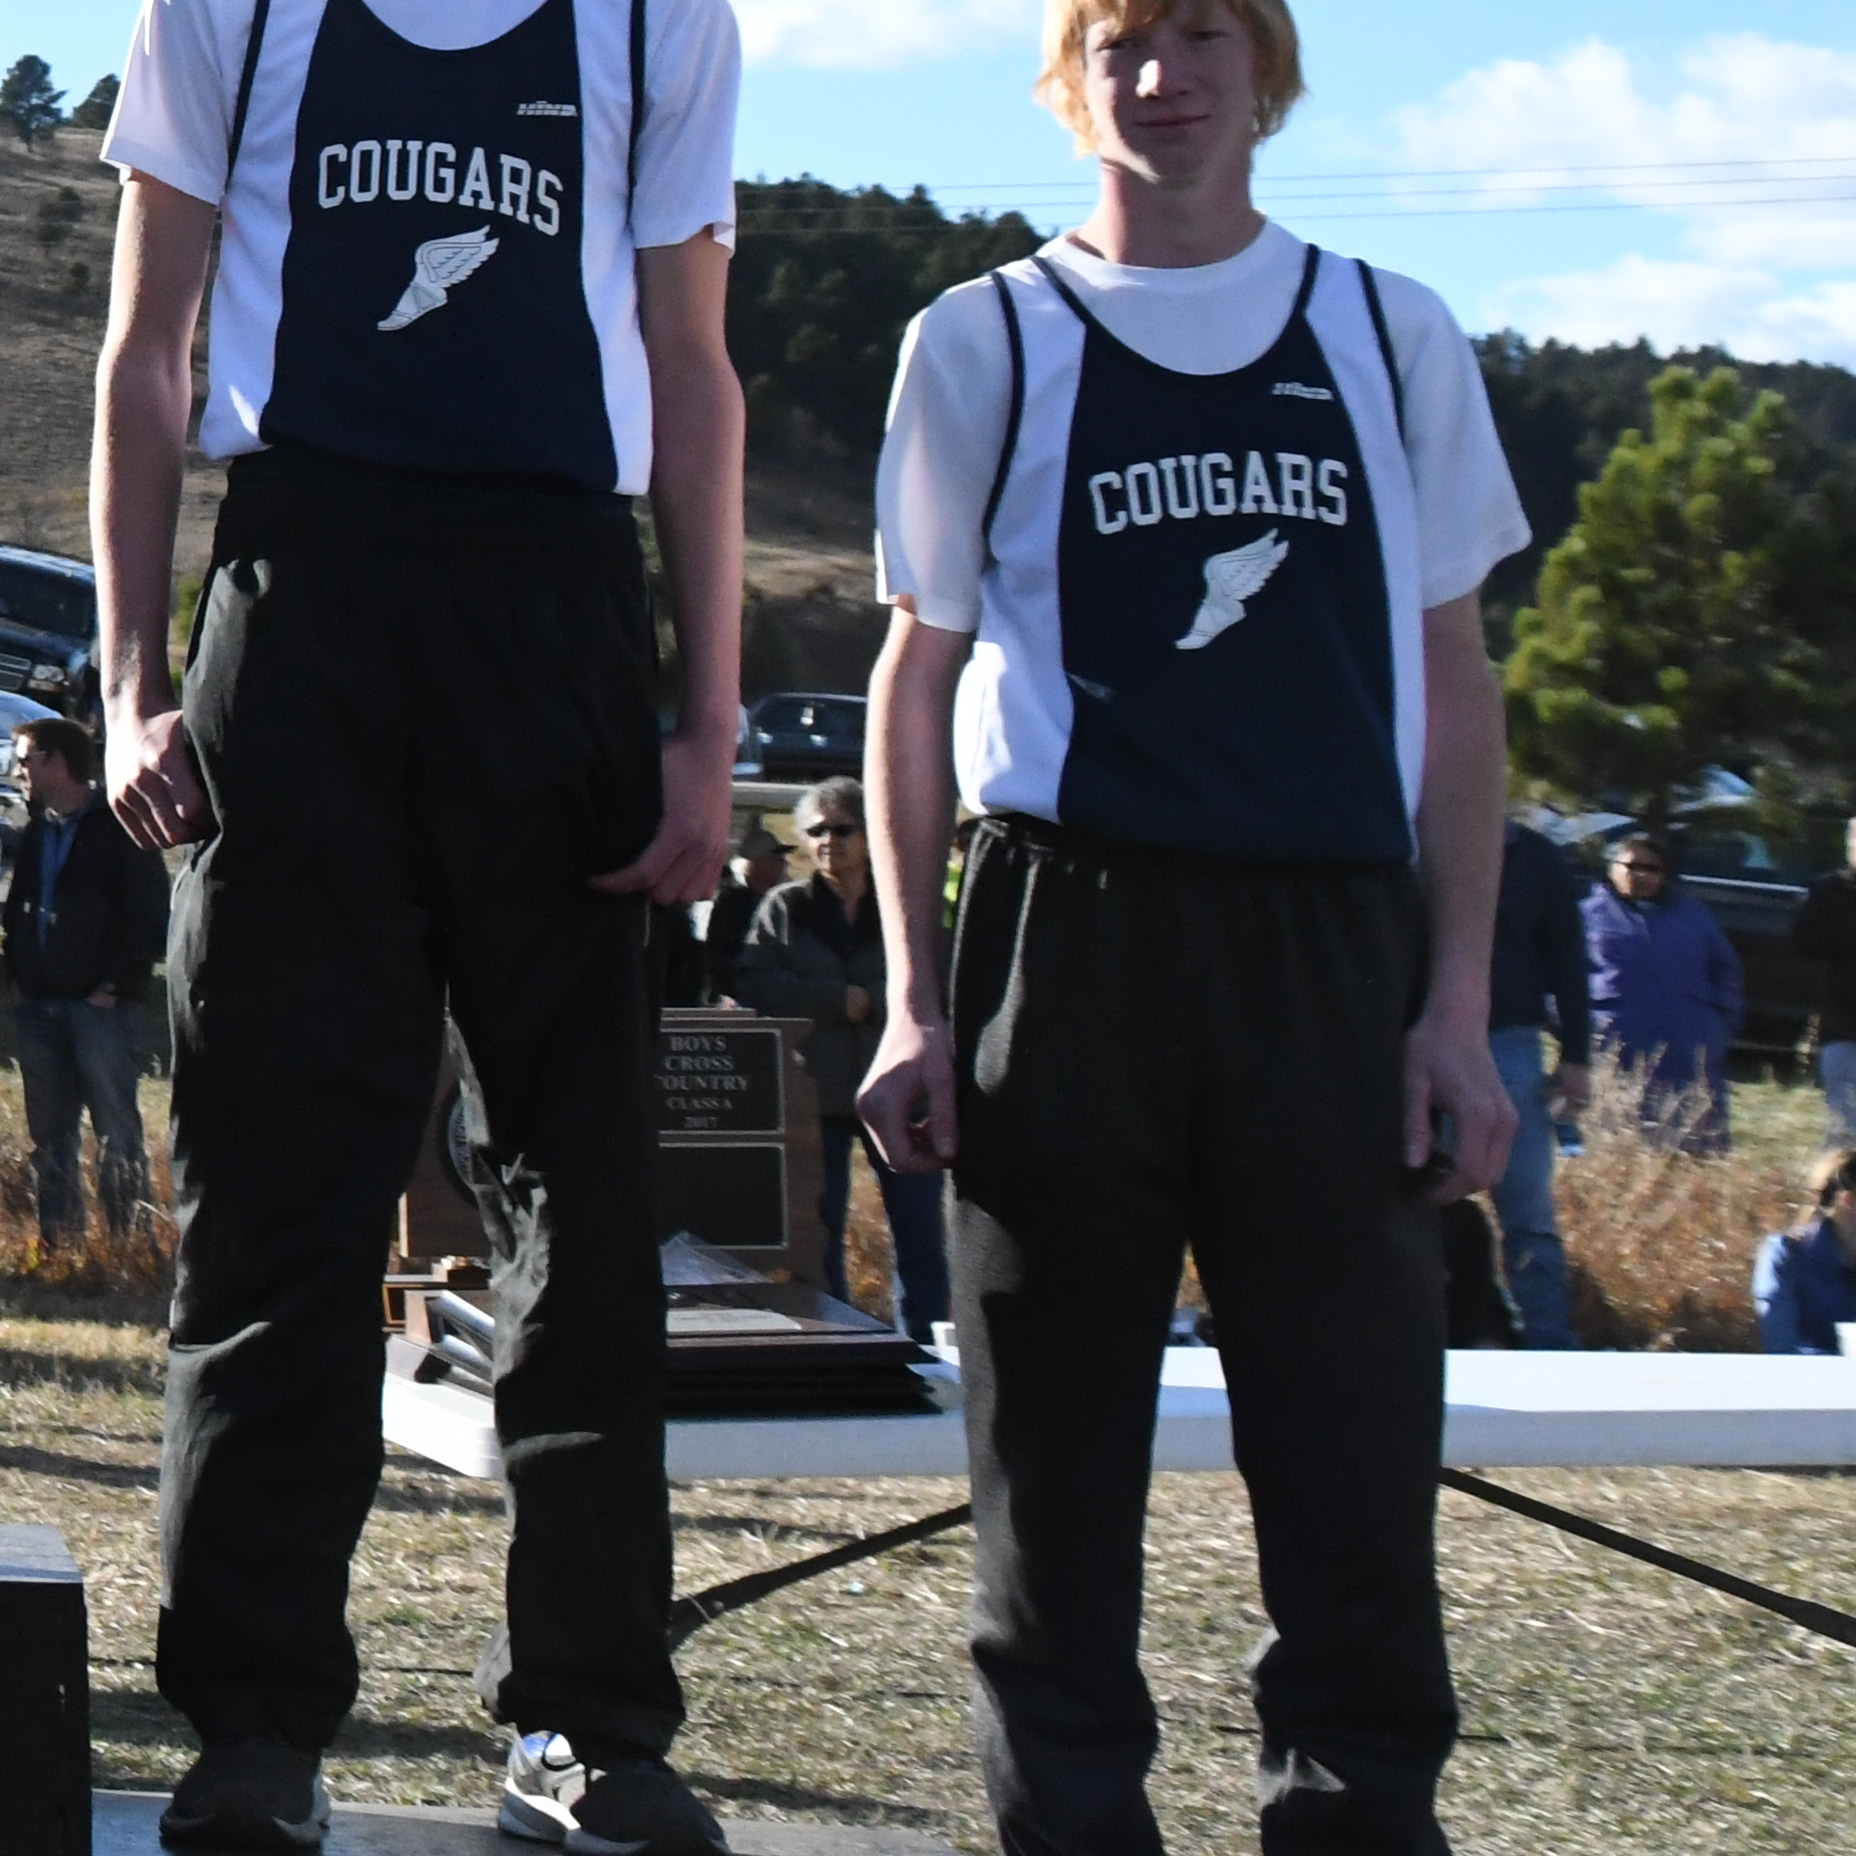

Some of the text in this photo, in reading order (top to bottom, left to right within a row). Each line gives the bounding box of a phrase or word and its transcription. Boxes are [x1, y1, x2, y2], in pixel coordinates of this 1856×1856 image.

[317, 139, 565, 236] COUGARS
[1088, 449, 1349, 535] COUGARS
[671, 1036, 727, 1052] BOYS
[665, 1055, 734, 1071] CROSS
[653, 1074, 748, 1091] OUNTRY
